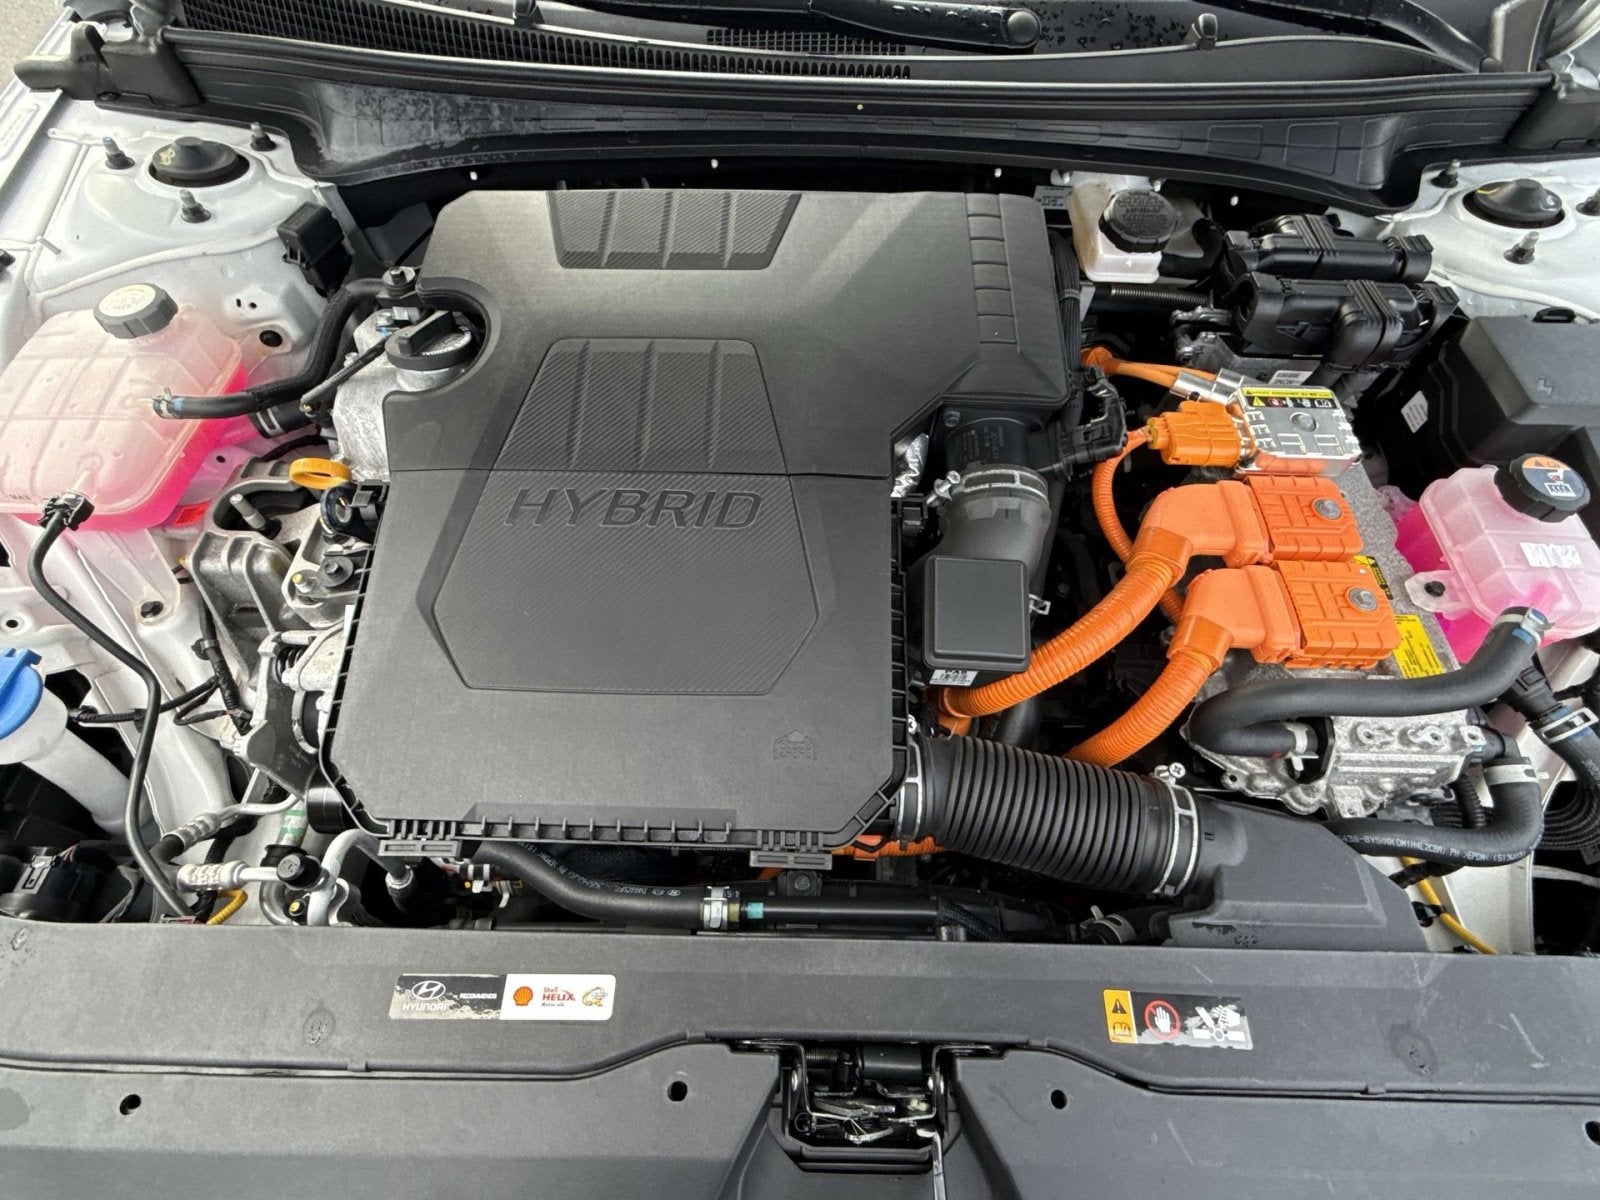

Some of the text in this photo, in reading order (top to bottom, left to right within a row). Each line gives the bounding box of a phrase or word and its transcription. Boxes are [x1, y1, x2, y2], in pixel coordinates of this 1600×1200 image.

[503, 487, 764, 530] HYBRID
[459, 992, 498, 1000] RECOMMENDS
[542, 993, 575, 1001] HELIX
[402, 1002, 448, 1012] HYUNDAI
